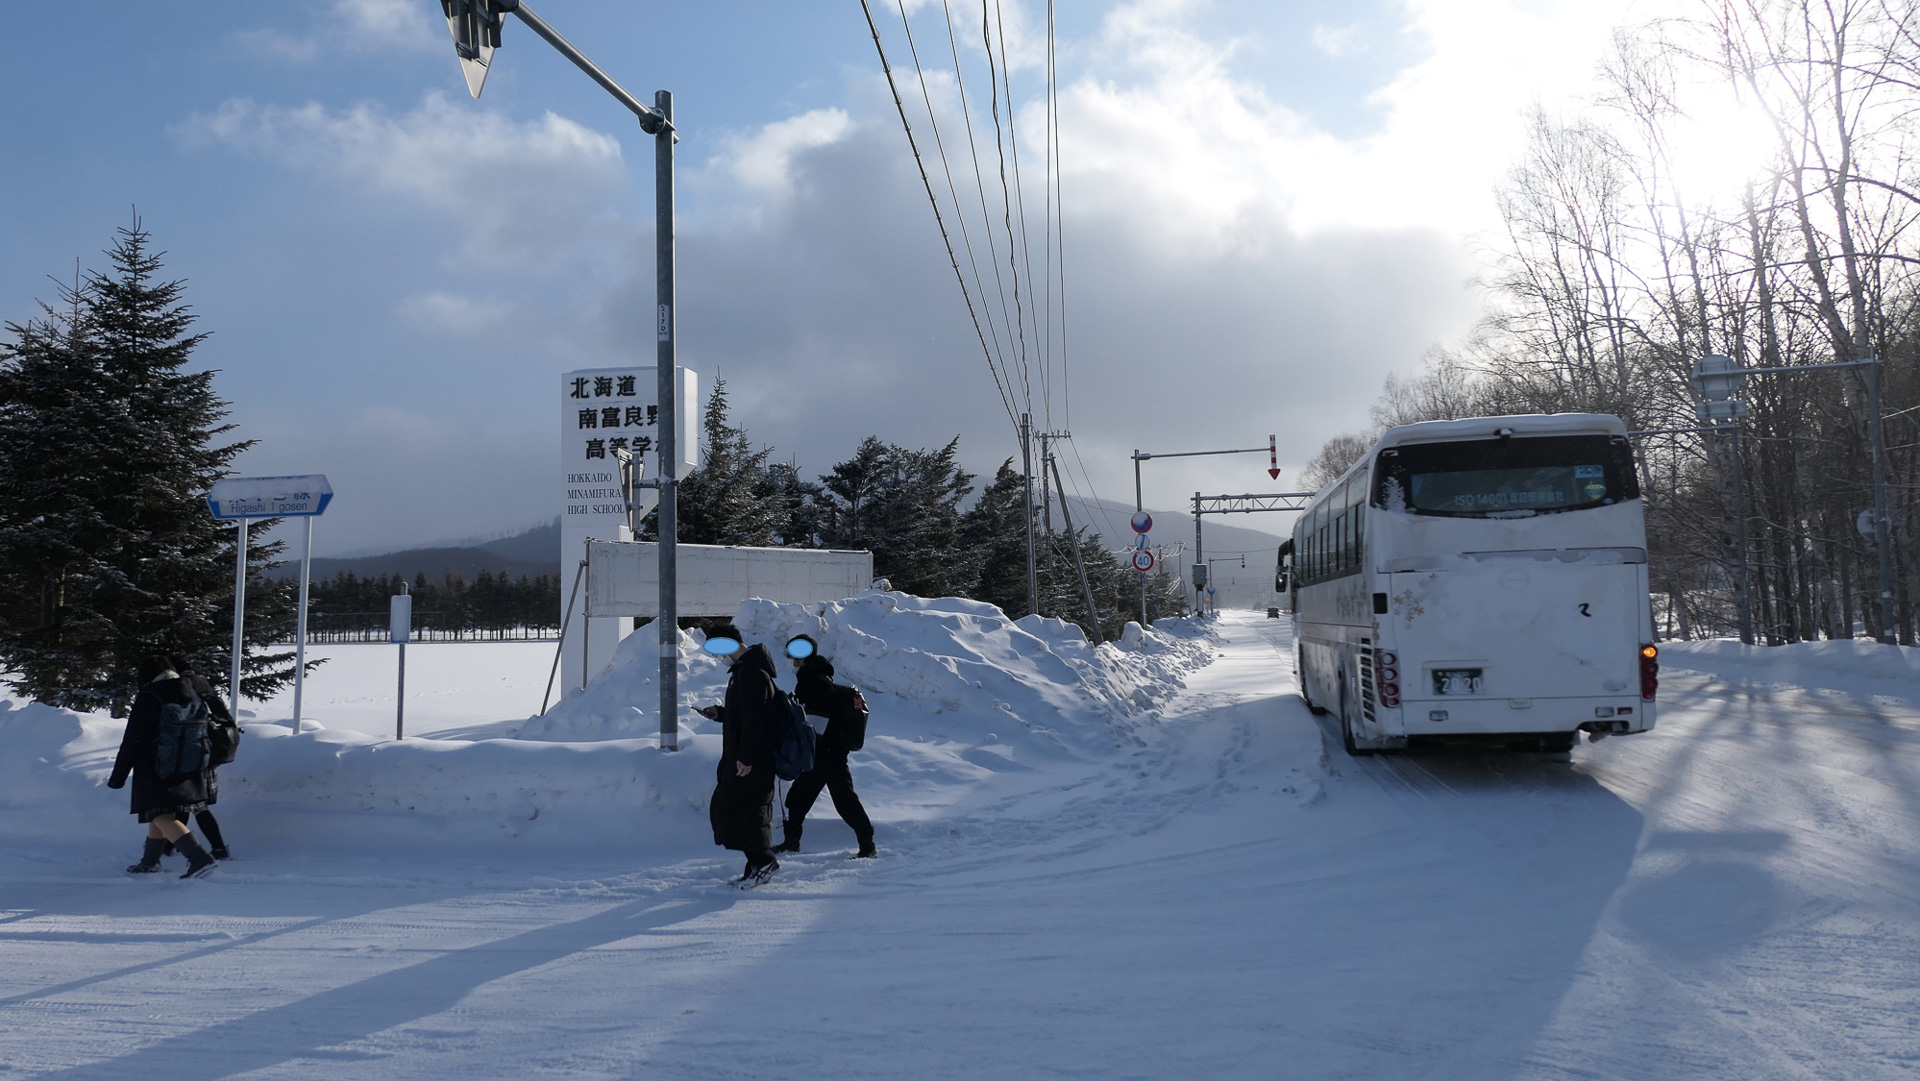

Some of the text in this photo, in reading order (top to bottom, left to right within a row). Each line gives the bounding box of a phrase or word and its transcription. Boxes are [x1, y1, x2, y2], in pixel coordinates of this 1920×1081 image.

[570, 375, 637, 399] 北海道
[585, 436, 659, 460] 高等学
[567, 472, 612, 483] HOKKAIDO
[567, 488, 624, 500] MINAMIFURA
[1454, 494, 1475, 507] ISO
[1477, 493, 1508, 506] 14001
[230, 501, 308, 515] Higashi 1 gosen
[567, 503, 625, 515] HIGH SCHOOL
[1138, 556, 1150, 566] 40
